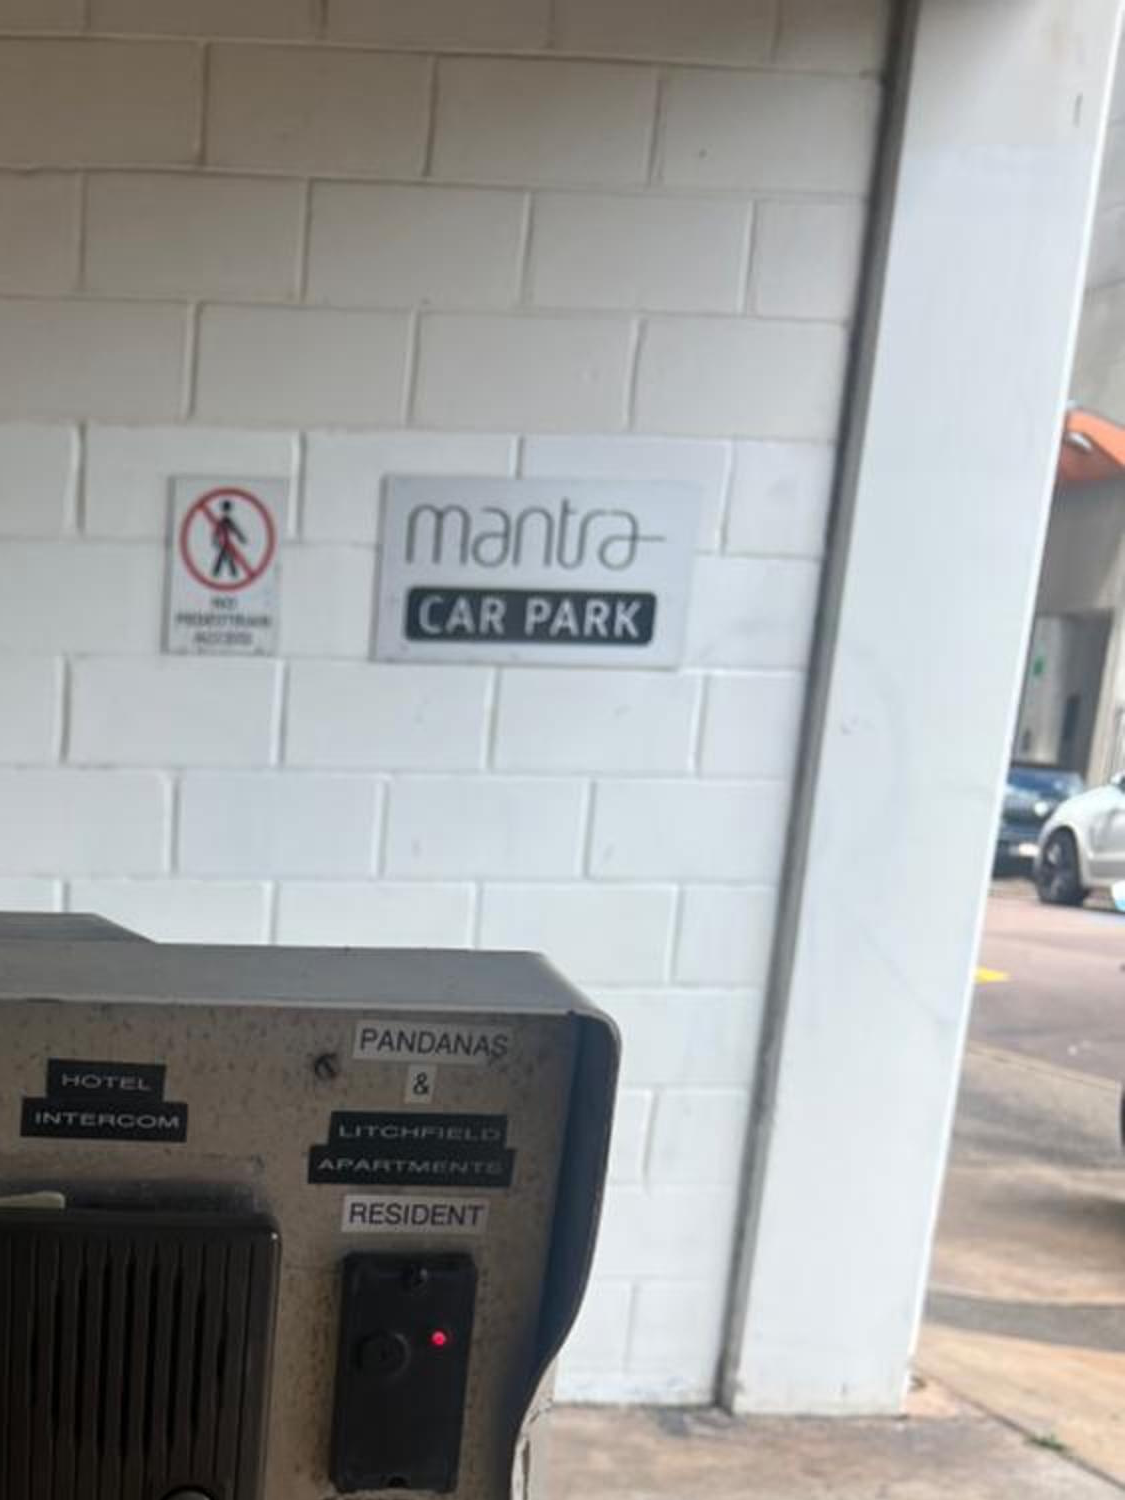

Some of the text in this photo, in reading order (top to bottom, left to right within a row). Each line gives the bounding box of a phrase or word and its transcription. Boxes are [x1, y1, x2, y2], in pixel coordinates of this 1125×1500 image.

[405, 498, 667, 570] mantra
[418, 596, 641, 638] CAR PARK
[359, 1028, 509, 1057] PANDANAS
[61, 1073, 152, 1092] HOTEL
[412, 1072, 430, 1095] &
[35, 1112, 180, 1129] INTERCOM
[338, 1124, 501, 1142] LITCHFIELD
[317, 1157, 506, 1176] APARTMENTS
[349, 1203, 486, 1226] RESIDENT
